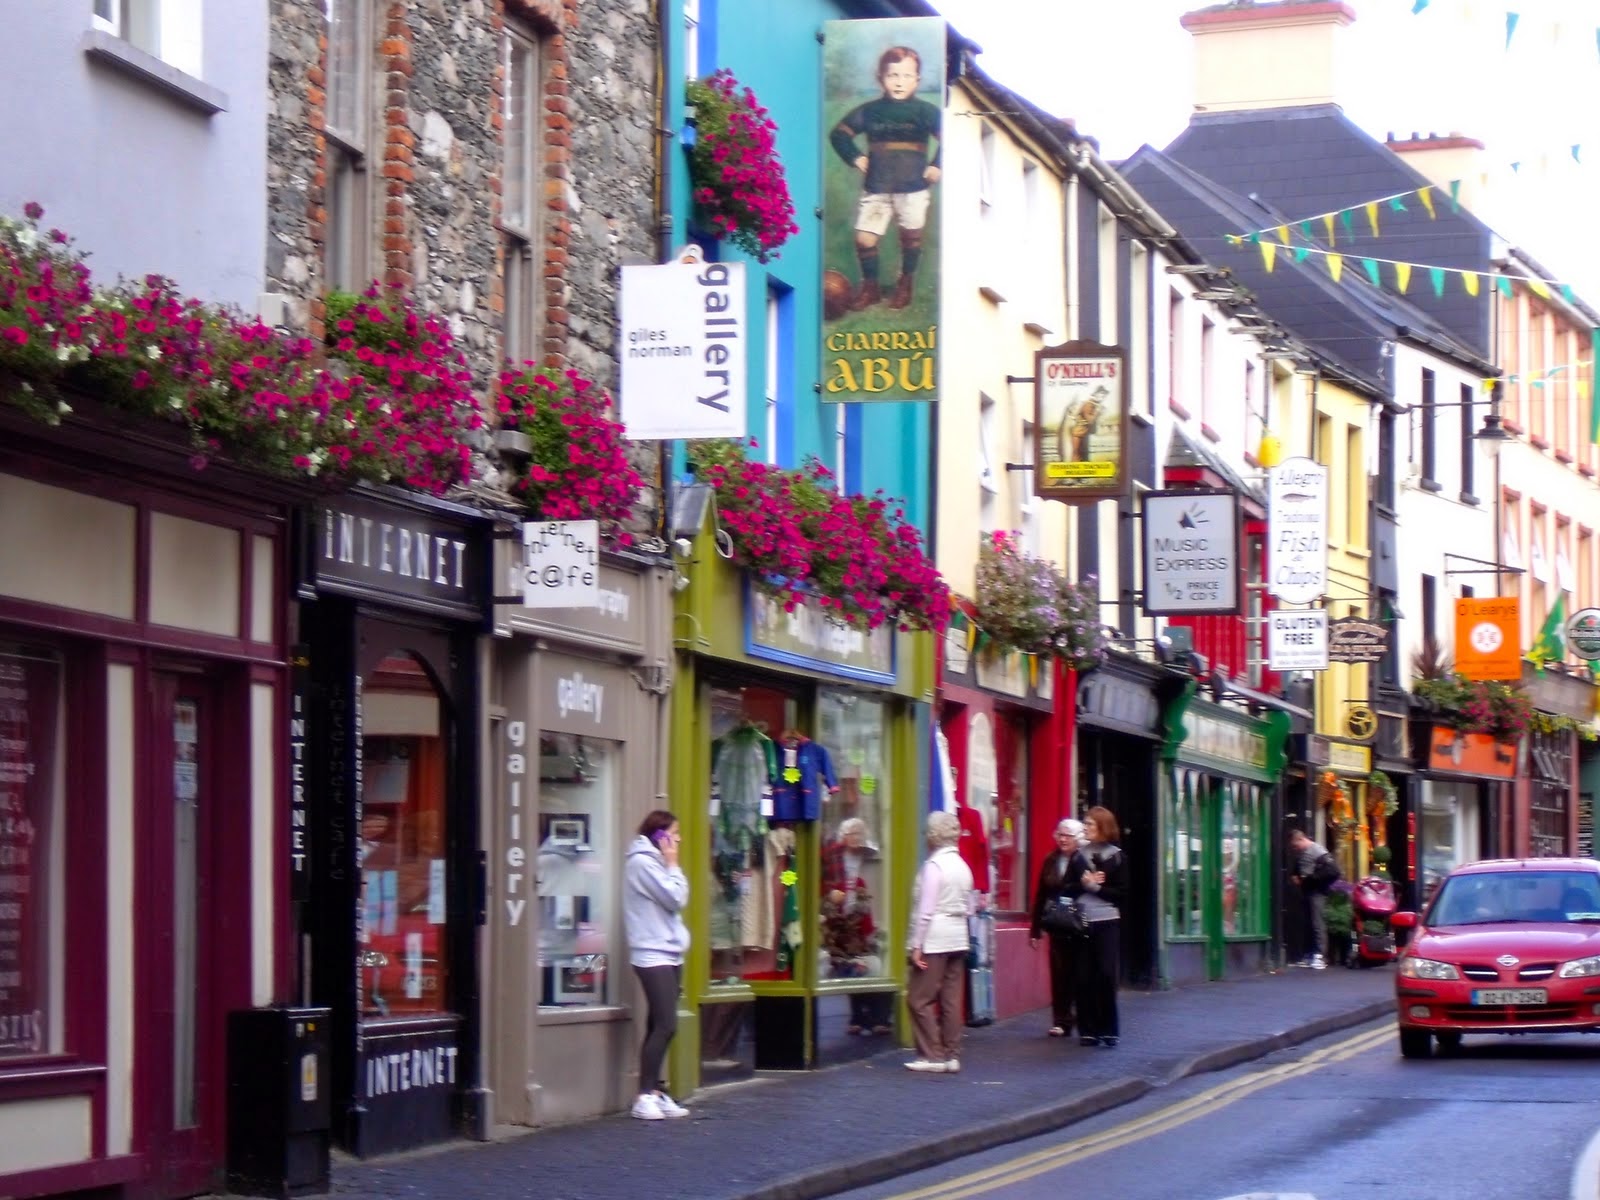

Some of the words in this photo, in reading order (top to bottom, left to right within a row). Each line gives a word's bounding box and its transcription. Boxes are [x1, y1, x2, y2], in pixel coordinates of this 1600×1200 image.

[629, 327, 667, 344] giles
[697, 263, 738, 413] gallery
[629, 343, 692, 358] norman
[826, 352, 936, 392] ABÚ
[1047, 362, 1116, 379] O'NEILL'S
[1276, 469, 1323, 488] Allegro
[325, 508, 467, 588] INTERNET
[1277, 529, 1320, 553] Fish
[525, 564, 594, 588] c@fe
[1187, 581, 1219, 590] PRICE
[1275, 564, 1321, 588] Chips
[1276, 617, 1323, 630] GLUTEN
[1284, 632, 1315, 645] FREE
[558, 671, 604, 724] gallery
[290, 695, 306, 871] INTERNET
[506, 720, 526, 926] gallery
[366, 1046, 459, 1098] INTERNET
